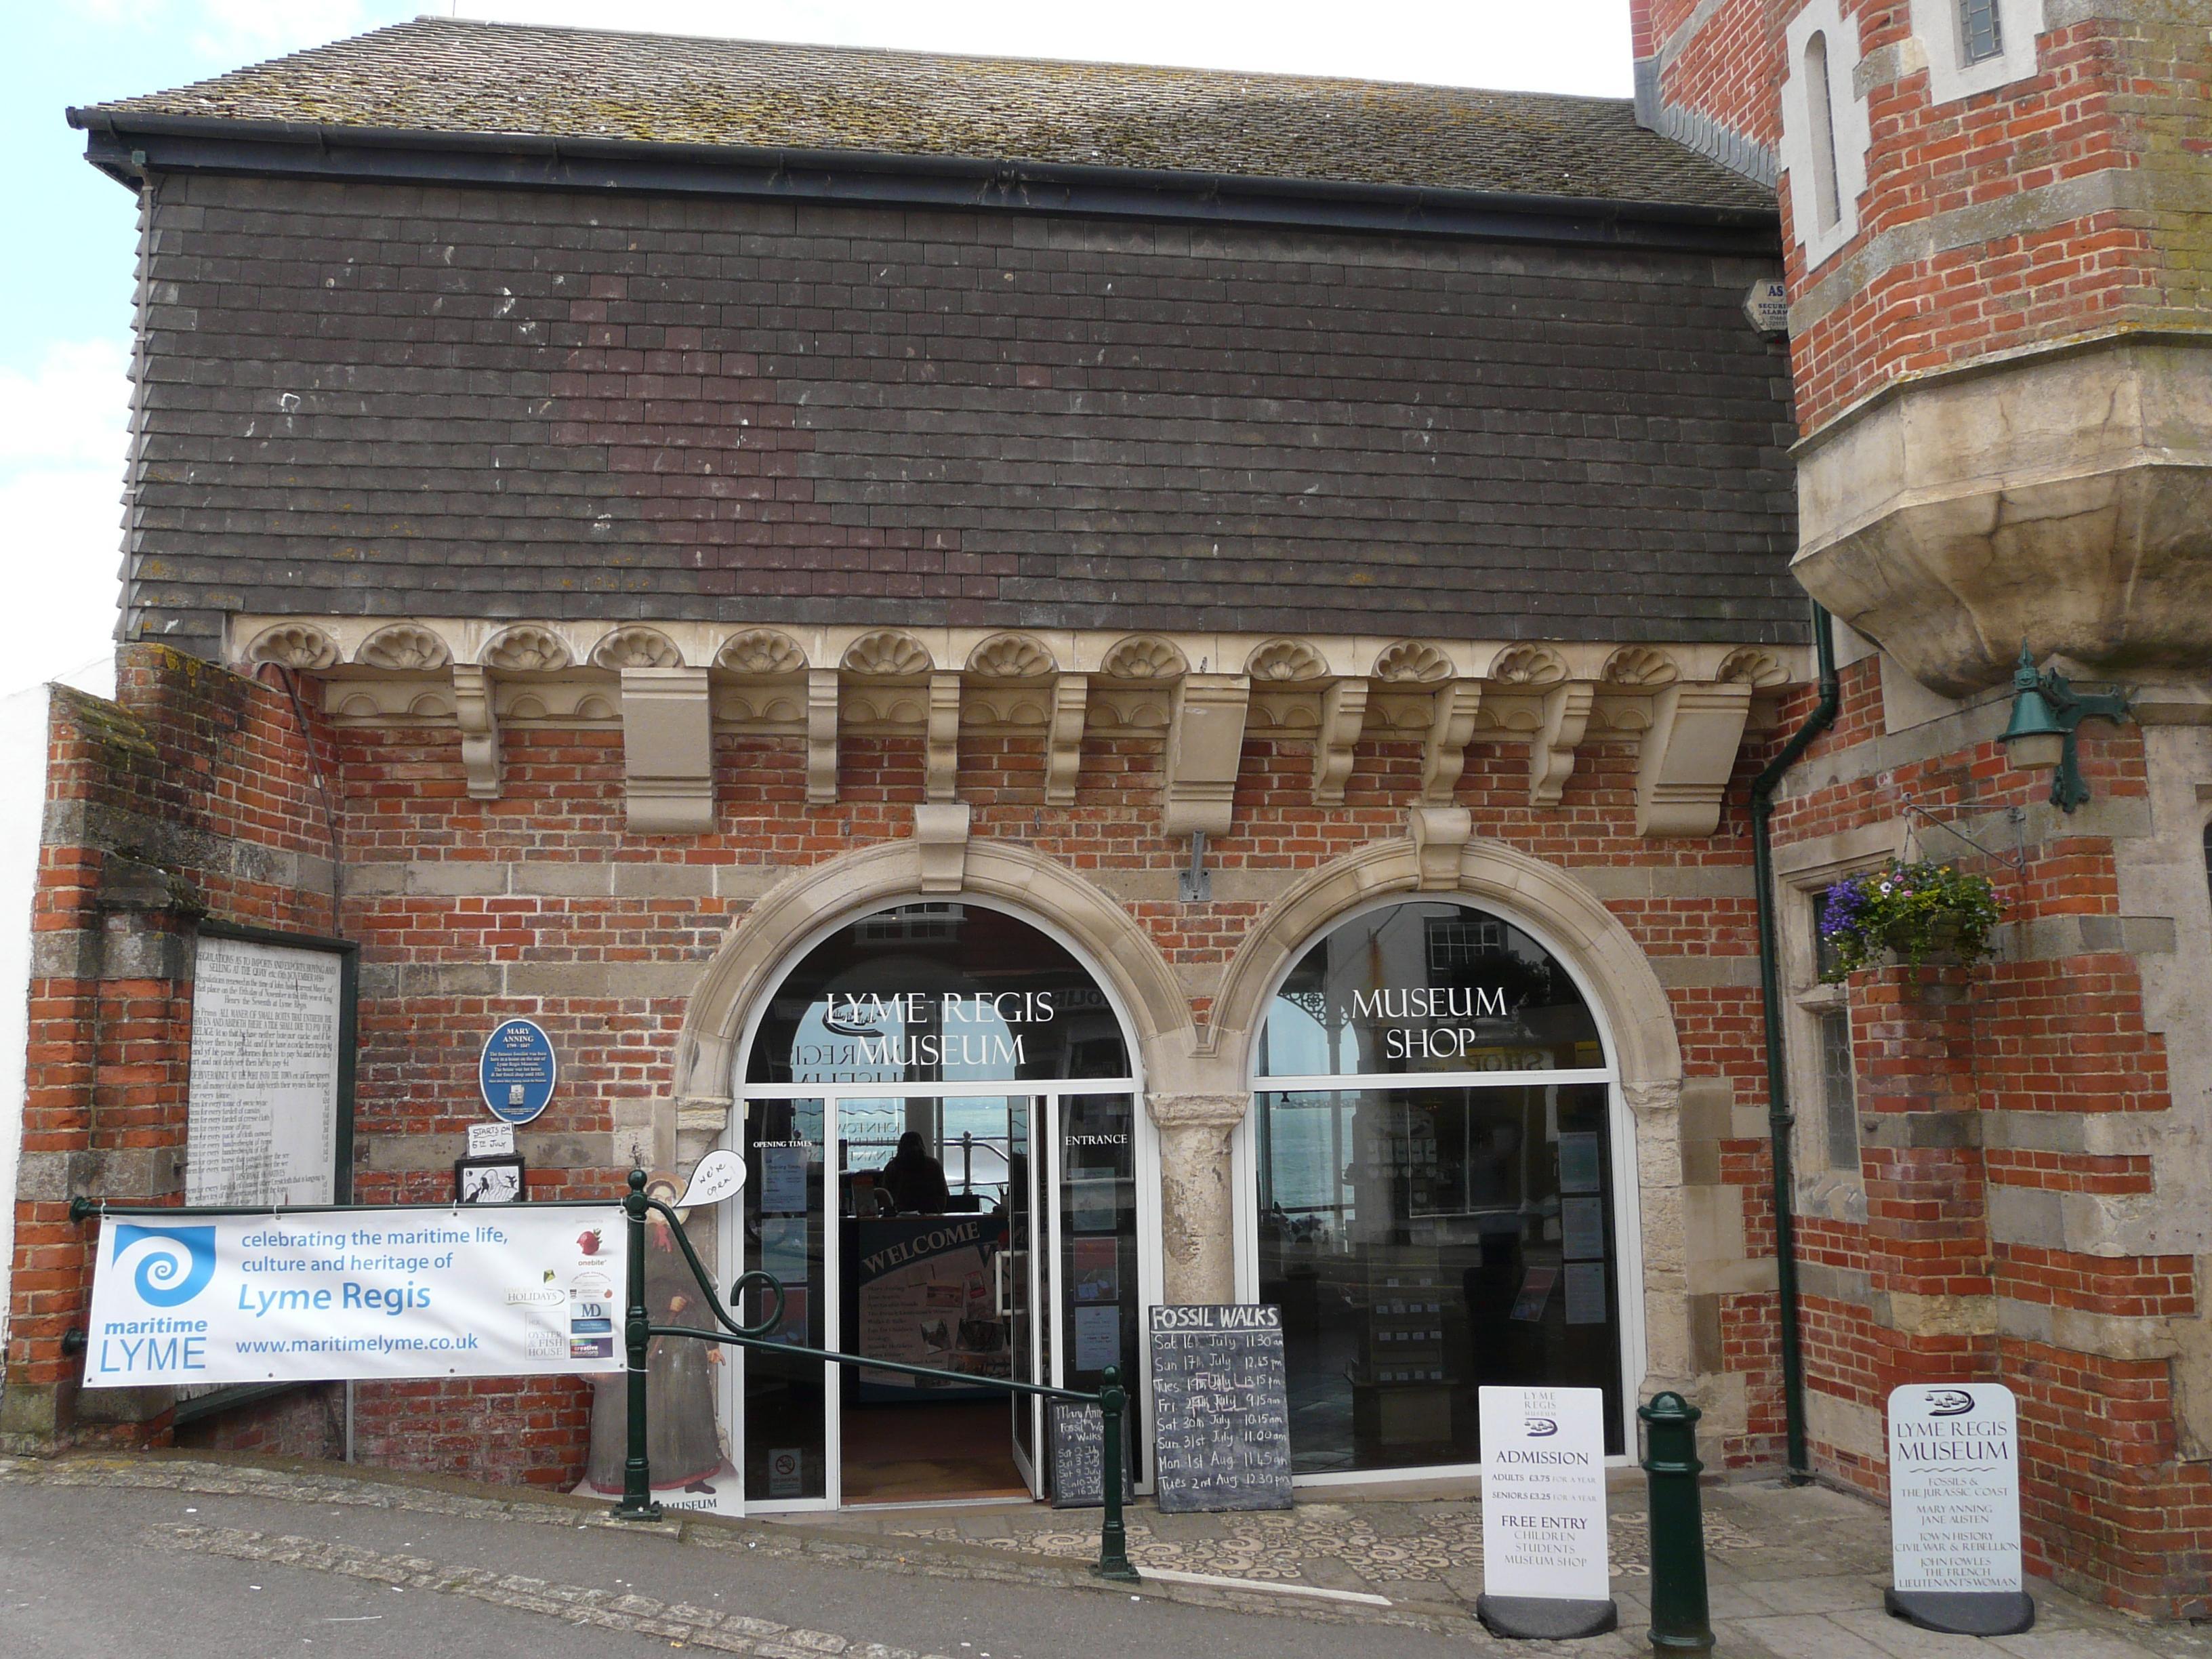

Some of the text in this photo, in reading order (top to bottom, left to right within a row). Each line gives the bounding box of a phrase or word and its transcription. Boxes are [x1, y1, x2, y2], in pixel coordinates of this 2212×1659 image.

[825, 991, 1054, 1023] LYME REGIS
[1352, 987, 1507, 1019] MUSEUM
[855, 1034, 1026, 1065] MUSEUM
[1387, 1028, 1475, 1059] SHOP
[472, 1126, 499, 1137] STARTS
[489, 1139, 507, 1148] JULY
[1065, 1134, 1128, 1145] ENTRANCE
[242, 1227, 509, 1250] celebrating the maritime life,
[862, 1221, 981, 1274] WELCOME
[242, 1252, 454, 1273] culture and heritage of
[238, 1280, 431, 1318] Lyme Regis
[508, 1292, 558, 1301] HOLIDAYS
[581, 1303, 602, 1317] MD
[1152, 1307, 1279, 1330] FOSSIL WALKS
[104, 1317, 208, 1335] maritime
[528, 1331, 563, 1339] OYSTER
[235, 1332, 479, 1355] www.maritimelyme.co.uk
[539, 1338, 562, 1347] FISH
[1208, 1333, 1237, 1350] July
[100, 1336, 207, 1372] LYME
[528, 1347, 563, 1357] HOUSE
[1209, 1353, 1231, 1371] July
[1524, 1391, 1557, 1400] LYME
[1524, 1401, 1557, 1409] REGIS
[1056, 1404, 1083, 1425] Mary
[1210, 1414, 1230, 1429] July
[1897, 1420, 2008, 1437] LYME REGIS
[1076, 1431, 1103, 1441] Walks
[1183, 1434, 1206, 1448] 31st
[1210, 1431, 1233, 1448] July
[1058, 1445, 1100, 1458] Sat 2 July
[1898, 1441, 2009, 1461] MUSEUM
[1076, 1456, 1082, 1466] 3
[1084, 1456, 1100, 1467] July
[1158, 1455, 1181, 1473] Mon
[1187, 1454, 1204, 1469] 1st
[1496, 1450, 1589, 1465] ADMISSION
[1059, 1467, 1101, 1479] Sat 9 July
[1492, 1473, 1525, 1482] ADULTS
[1529, 1474, 1551, 1483] £3.75
[1086, 1476, 1101, 1488] July
[1158, 1475, 1187, 1491] Tues
[1191, 1477, 1211, 1490] 2nd
[1928, 1477, 1980, 1487] FOSSILS &
[1492, 1491, 1529, 1500] SENIORS
[1530, 1493, 1551, 1501] £3.25
[1902, 1487, 2009, 1499] THE JURASSIC COAST
[1916, 1504, 1994, 1513] MARY ANNING
[1502, 1515, 1588, 1530] FREE ENTRY
[1921, 1514, 1990, 1525] JANE AUSTEN
[1514, 1530, 1576, 1541] CHILDREN
[1919, 1532, 1994, 1542] TOWN HISTORY
[1515, 1542, 1576, 1554] STUDENTS
[1894, 1542, 2020, 1553] CIVIL WAR & REBELLION
[1504, 1555, 1588, 1567] MUSEUM SHOP
[1921, 1557, 1992, 1568] JOHN FOWLES
[1925, 1567, 1991, 1577] THE FRENCH
[1973, 1577, 2018, 1588] WOMAN
